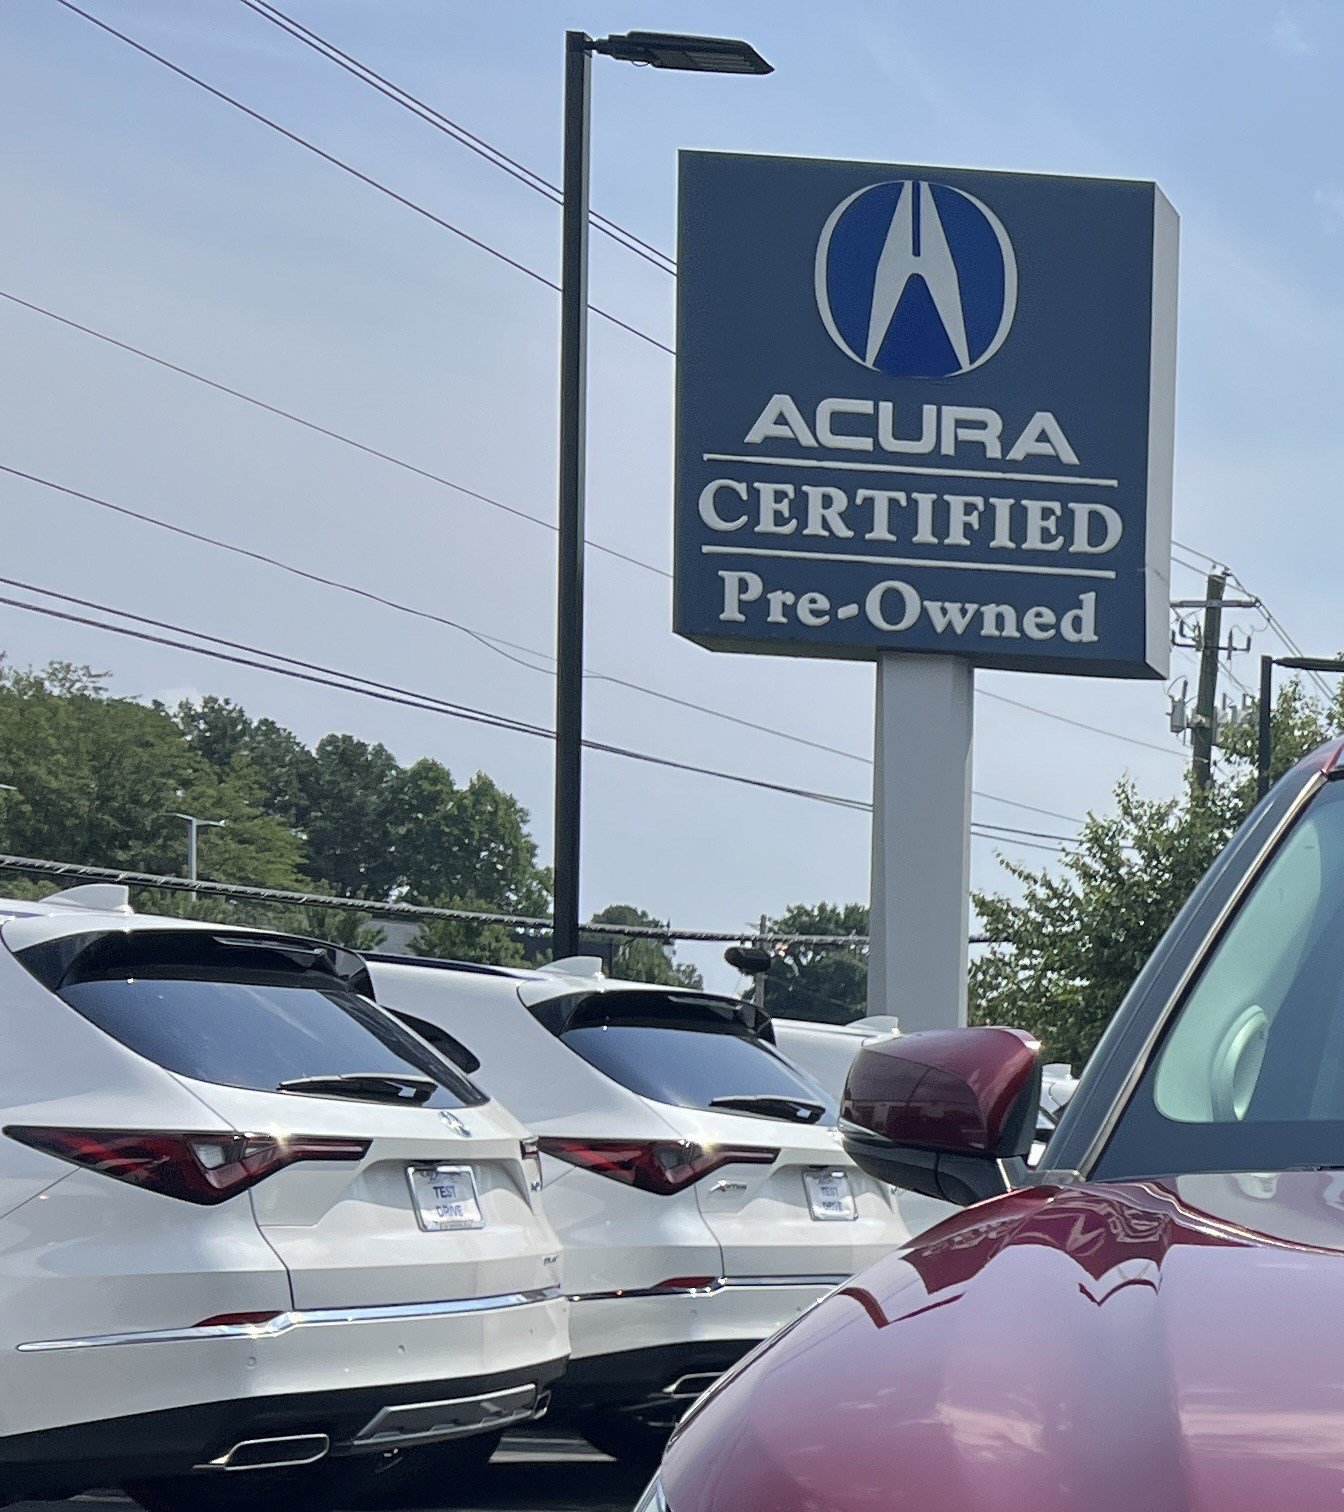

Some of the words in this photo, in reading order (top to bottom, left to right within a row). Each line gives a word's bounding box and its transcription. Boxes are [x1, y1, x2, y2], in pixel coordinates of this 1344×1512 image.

[743, 393, 1080, 466] ACURA
[698, 477, 1124, 555] CERTIFIED
[717, 568, 1100, 644] Pre-Owned
[432, 1185, 457, 1199] TEST
